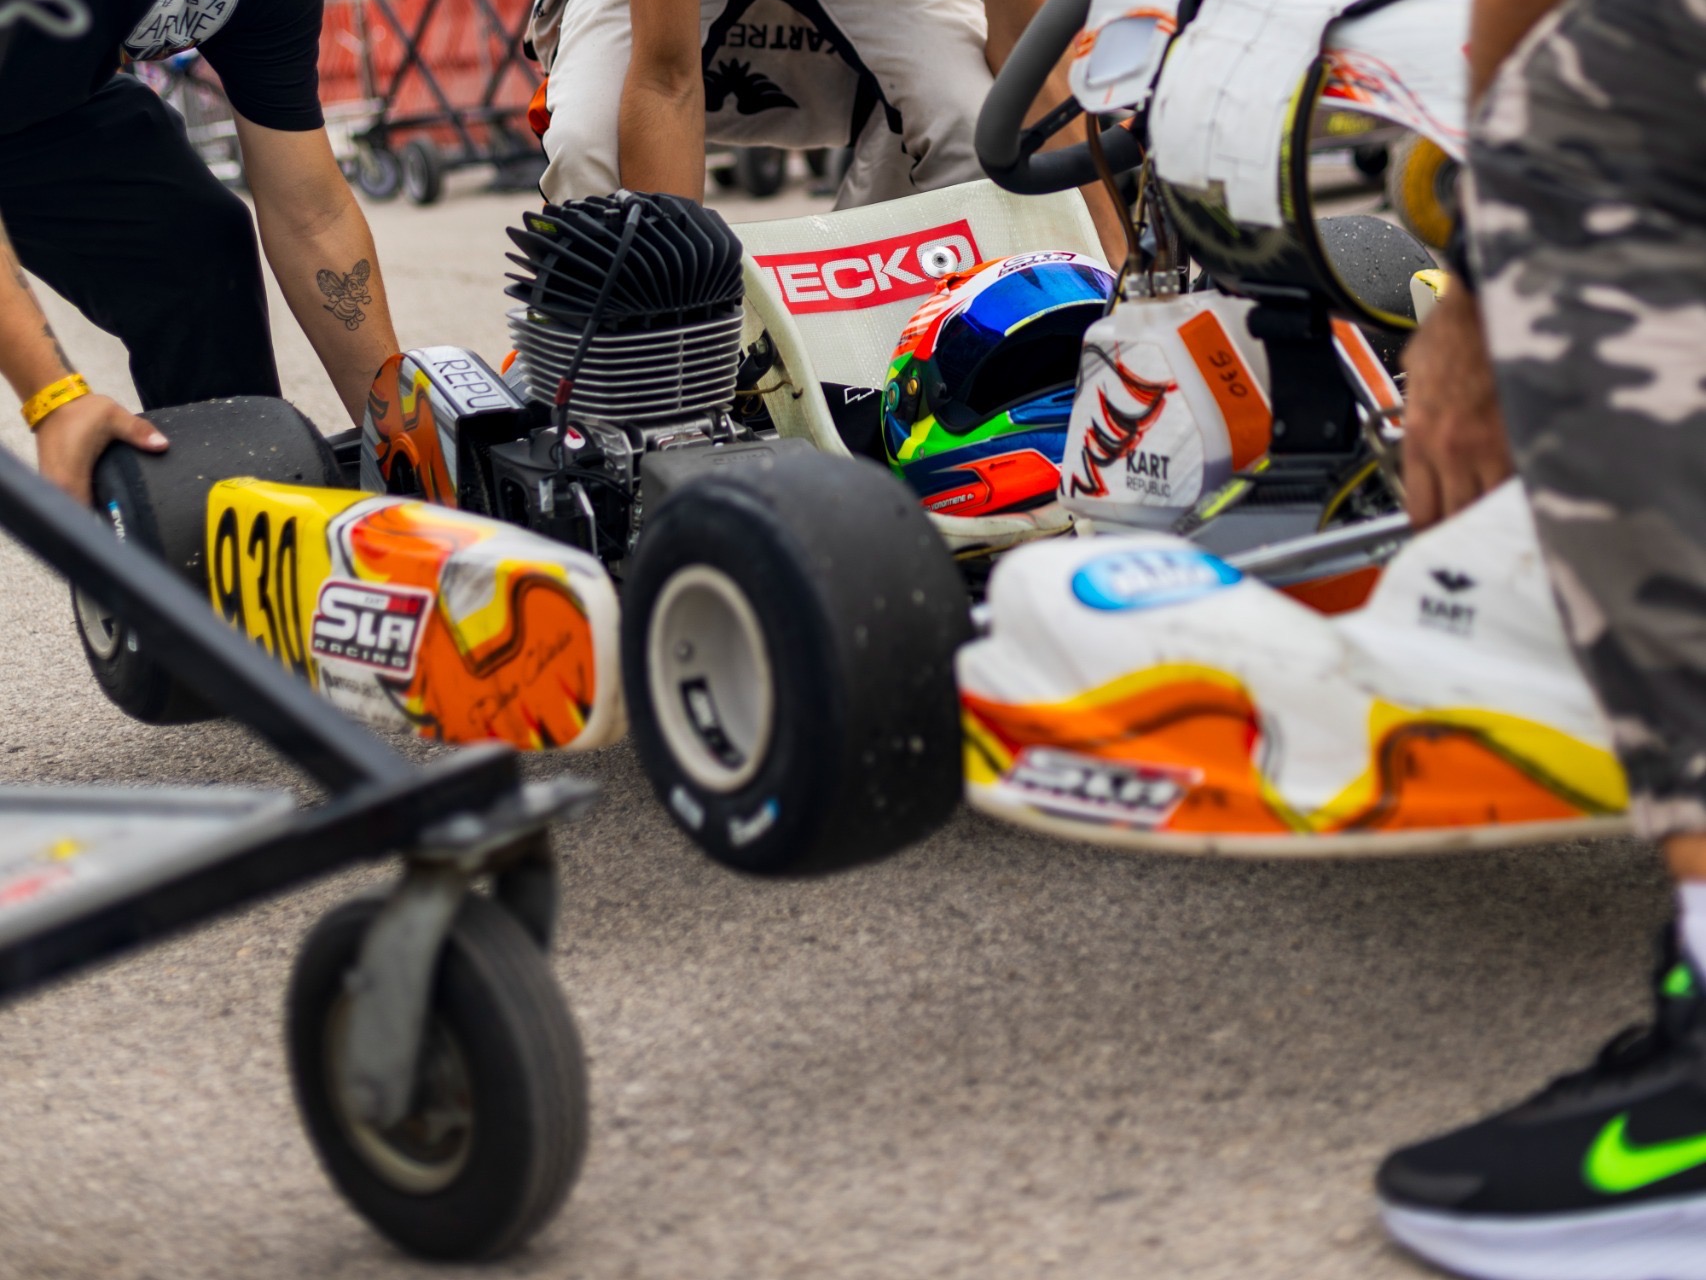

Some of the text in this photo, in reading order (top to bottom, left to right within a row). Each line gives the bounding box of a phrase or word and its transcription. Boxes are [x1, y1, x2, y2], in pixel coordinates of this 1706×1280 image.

[432, 359, 507, 409] REPU
[1126, 450, 1171, 480] KART
[1126, 475, 1172, 498] REPUBLIC
[314, 586, 417, 653] SLA
[313, 638, 409, 669] RACING
